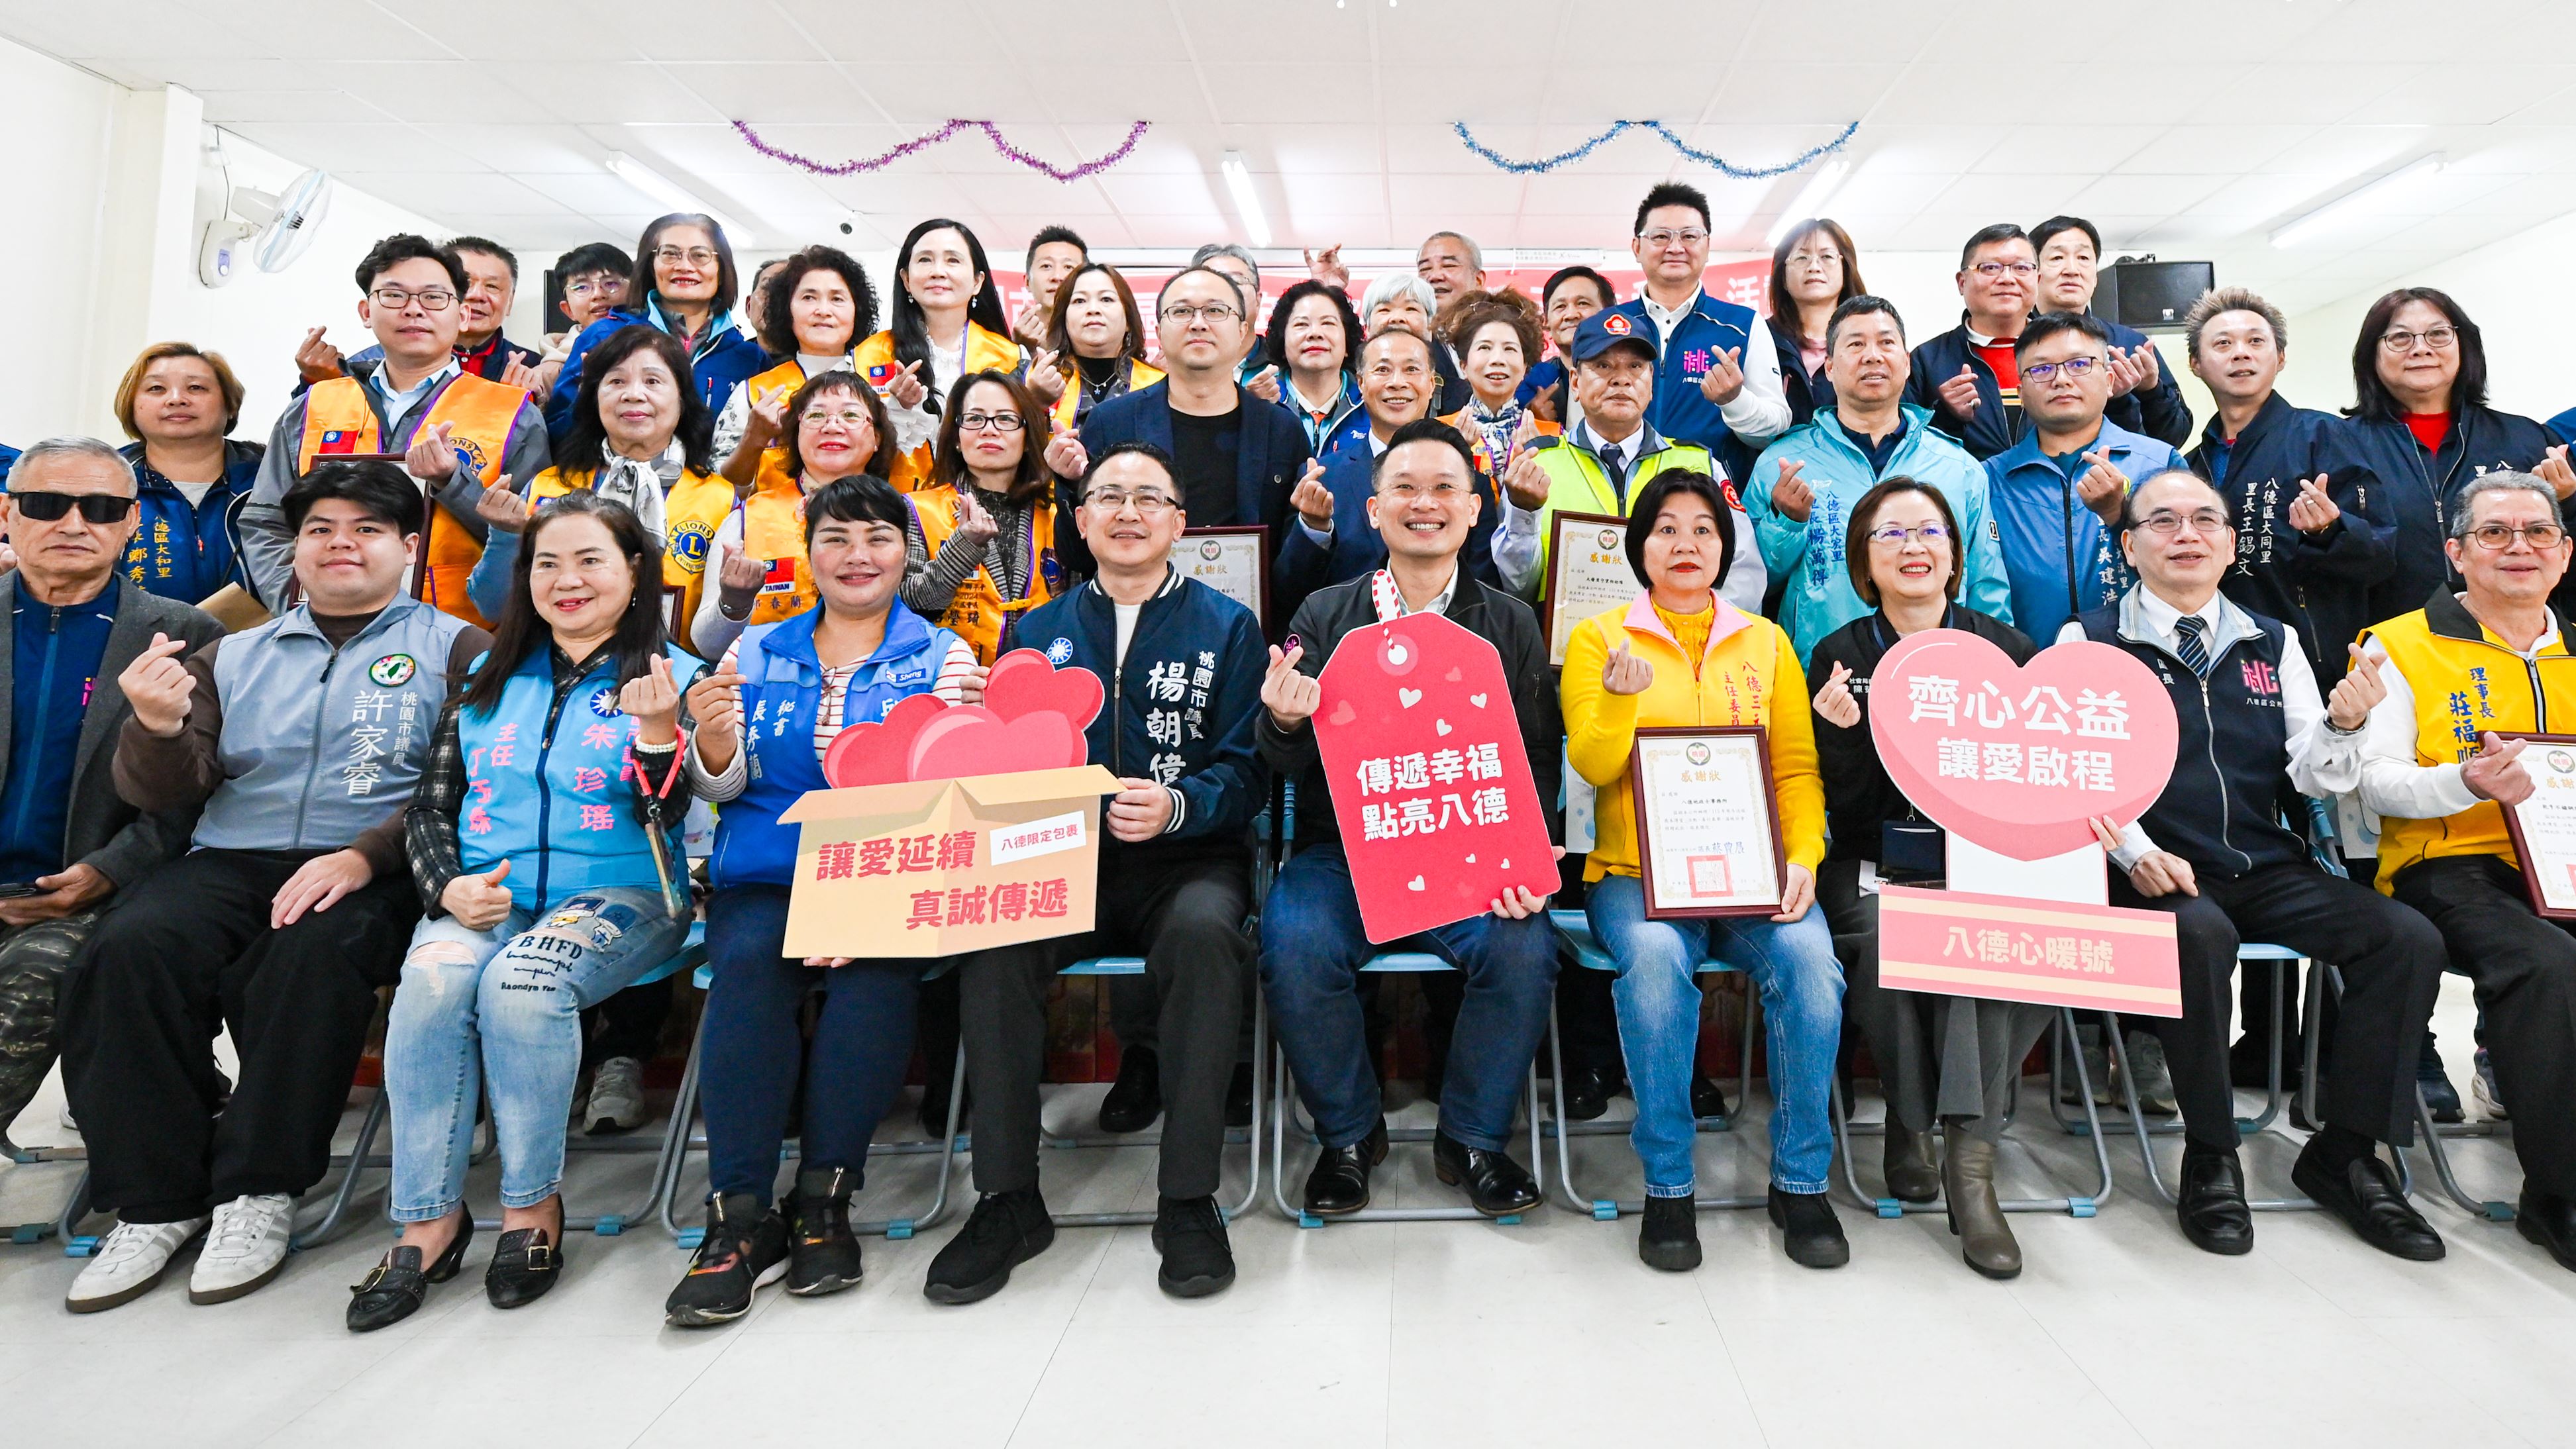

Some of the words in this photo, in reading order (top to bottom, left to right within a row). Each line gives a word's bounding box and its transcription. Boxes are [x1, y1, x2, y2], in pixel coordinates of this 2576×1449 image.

[680, 523, 712, 537] LIONS
[688, 536, 701, 557] L
[1826, 491, 1844, 562] 八德區大宏里
[2236, 482, 2257, 576] 里長王錫文
[2260, 477, 2280, 563] 八德區大同里
[1194, 564, 1227, 575] 感謝狀
[1590, 552, 1622, 565] 感謝狀
[900, 671, 922, 681] Sheng
[1184, 650, 1215, 740] 桃園市議員
[1724, 671, 1741, 726] 主任委員
[2469, 667, 2495, 718] 理事長
[392, 691, 418, 767] 桃園市議員
[1146, 661, 1188, 787] 楊朝偉
[1908, 675, 2130, 740] 齊心公益
[340, 689, 393, 795] 許家睿
[490, 723, 519, 767] 主任
[1937, 737, 2116, 792] 讓愛啟程
[1357, 742, 1503, 797] 傳遞幸福
[1681, 770, 1722, 783] 感謝狀
[1001, 823, 1079, 851] 八德限定包裹
[1362, 786, 1510, 842] 點亮八德
[816, 830, 977, 881] 讓愛延續
[905, 877, 1068, 930] 真誠傳遞
[1943, 926, 2115, 975] 八德心暖號
